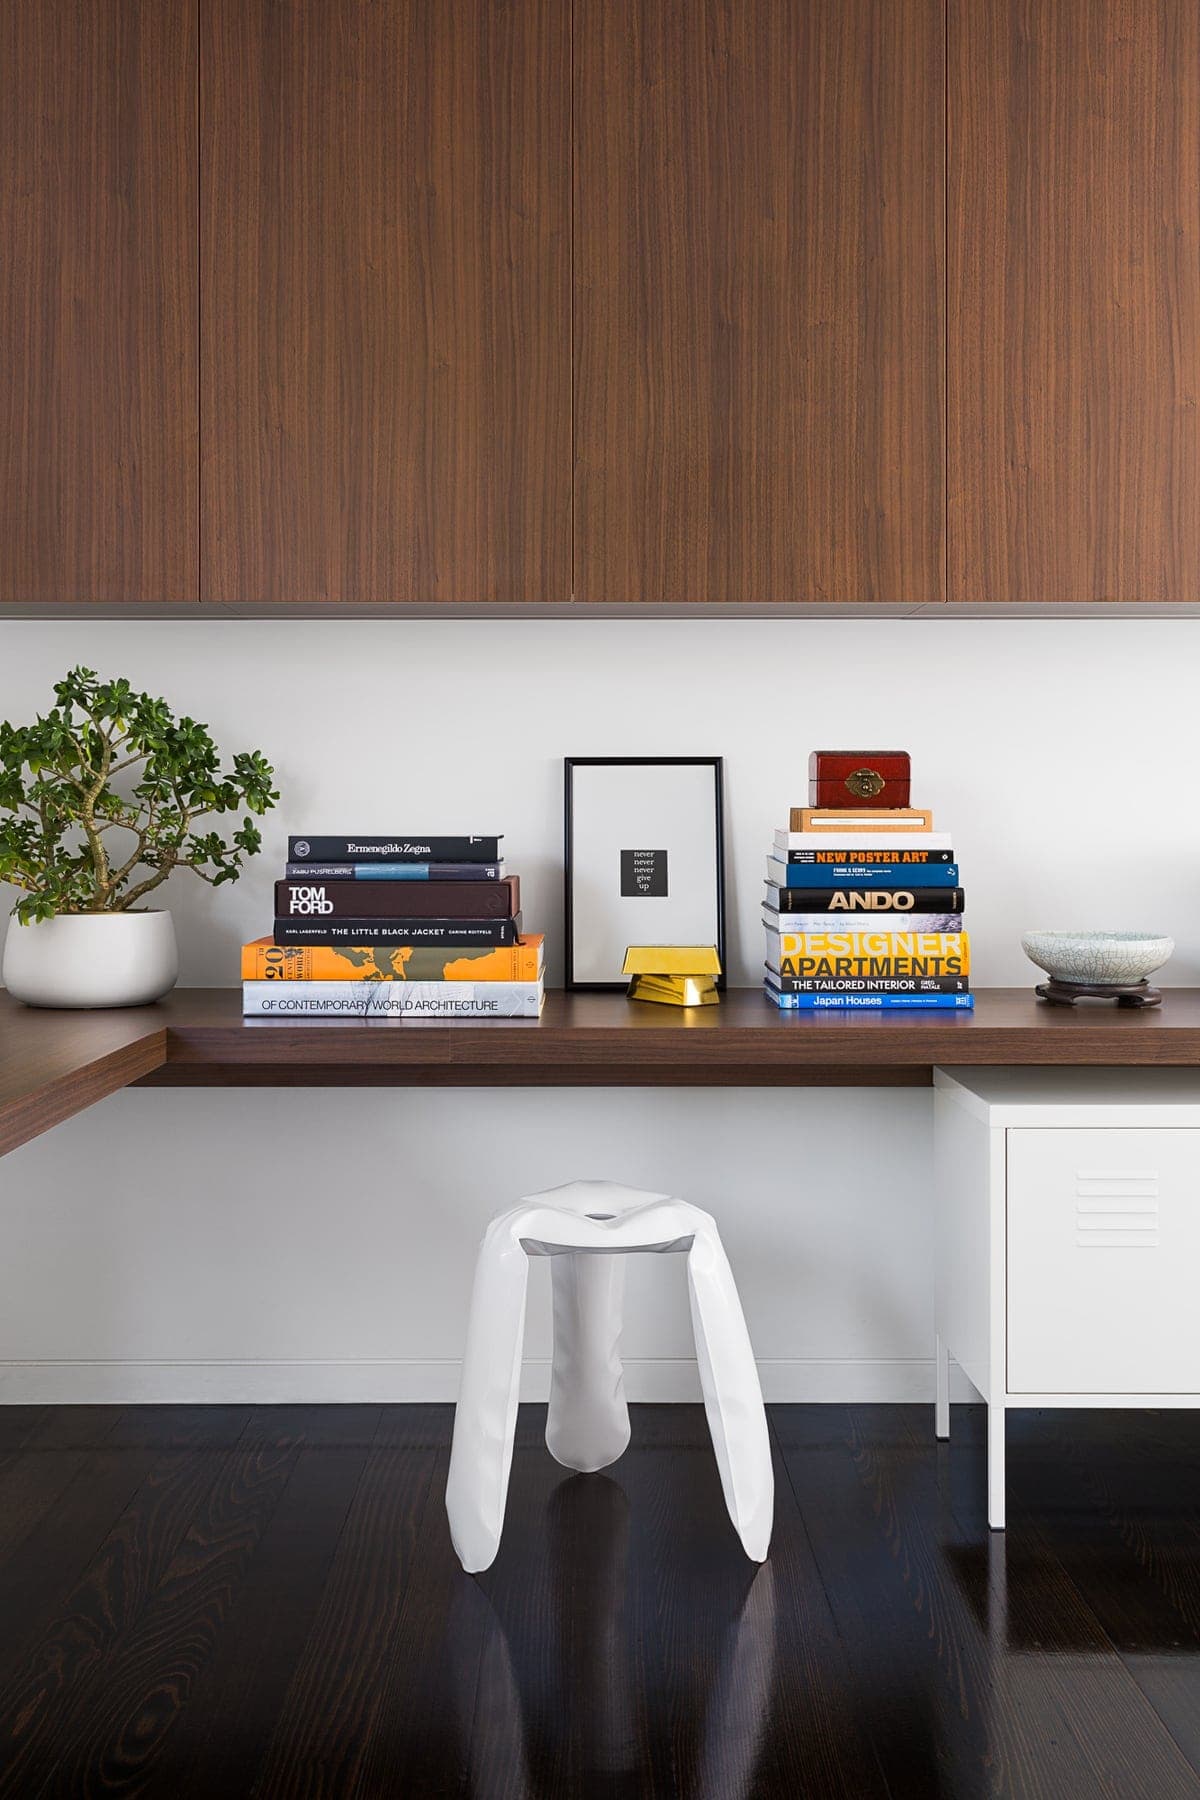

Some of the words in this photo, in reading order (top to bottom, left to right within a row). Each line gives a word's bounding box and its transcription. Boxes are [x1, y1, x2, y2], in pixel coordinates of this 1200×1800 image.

[347, 843, 402, 855] Ermenegildo
[403, 843, 431, 855] Zegna
[816, 851, 847, 863] NEW
[849, 851, 897, 863] POSTER
[899, 851, 928, 863] ART
[636, 875, 651, 884] give
[289, 886, 326, 901] TOM
[638, 884, 650, 892] up
[828, 891, 915, 910] ANDO
[289, 900, 334, 914] FORD
[331, 928, 349, 936] THE
[351, 928, 379, 936] LITTLE
[381, 928, 409, 936] BLACK
[411, 928, 445, 936] JACKET
[780, 932, 961, 955] DESIGNER
[265, 947, 284, 979] 20
[780, 957, 961, 976] APARTMENTS
[792, 980, 813, 990] THE
[814, 980, 866, 990] TAILORED
[867, 980, 915, 990] INTERIOR
[262, 1000, 278, 1010] OF
[279, 1000, 371, 1010] CONTEMPORARY
[372, 1000, 413, 1010] WORLD
[415, 1000, 498, 1010] ARCHITECTURE
[814, 996, 840, 1006] Japan
[841, 996, 882, 1006] Houses
